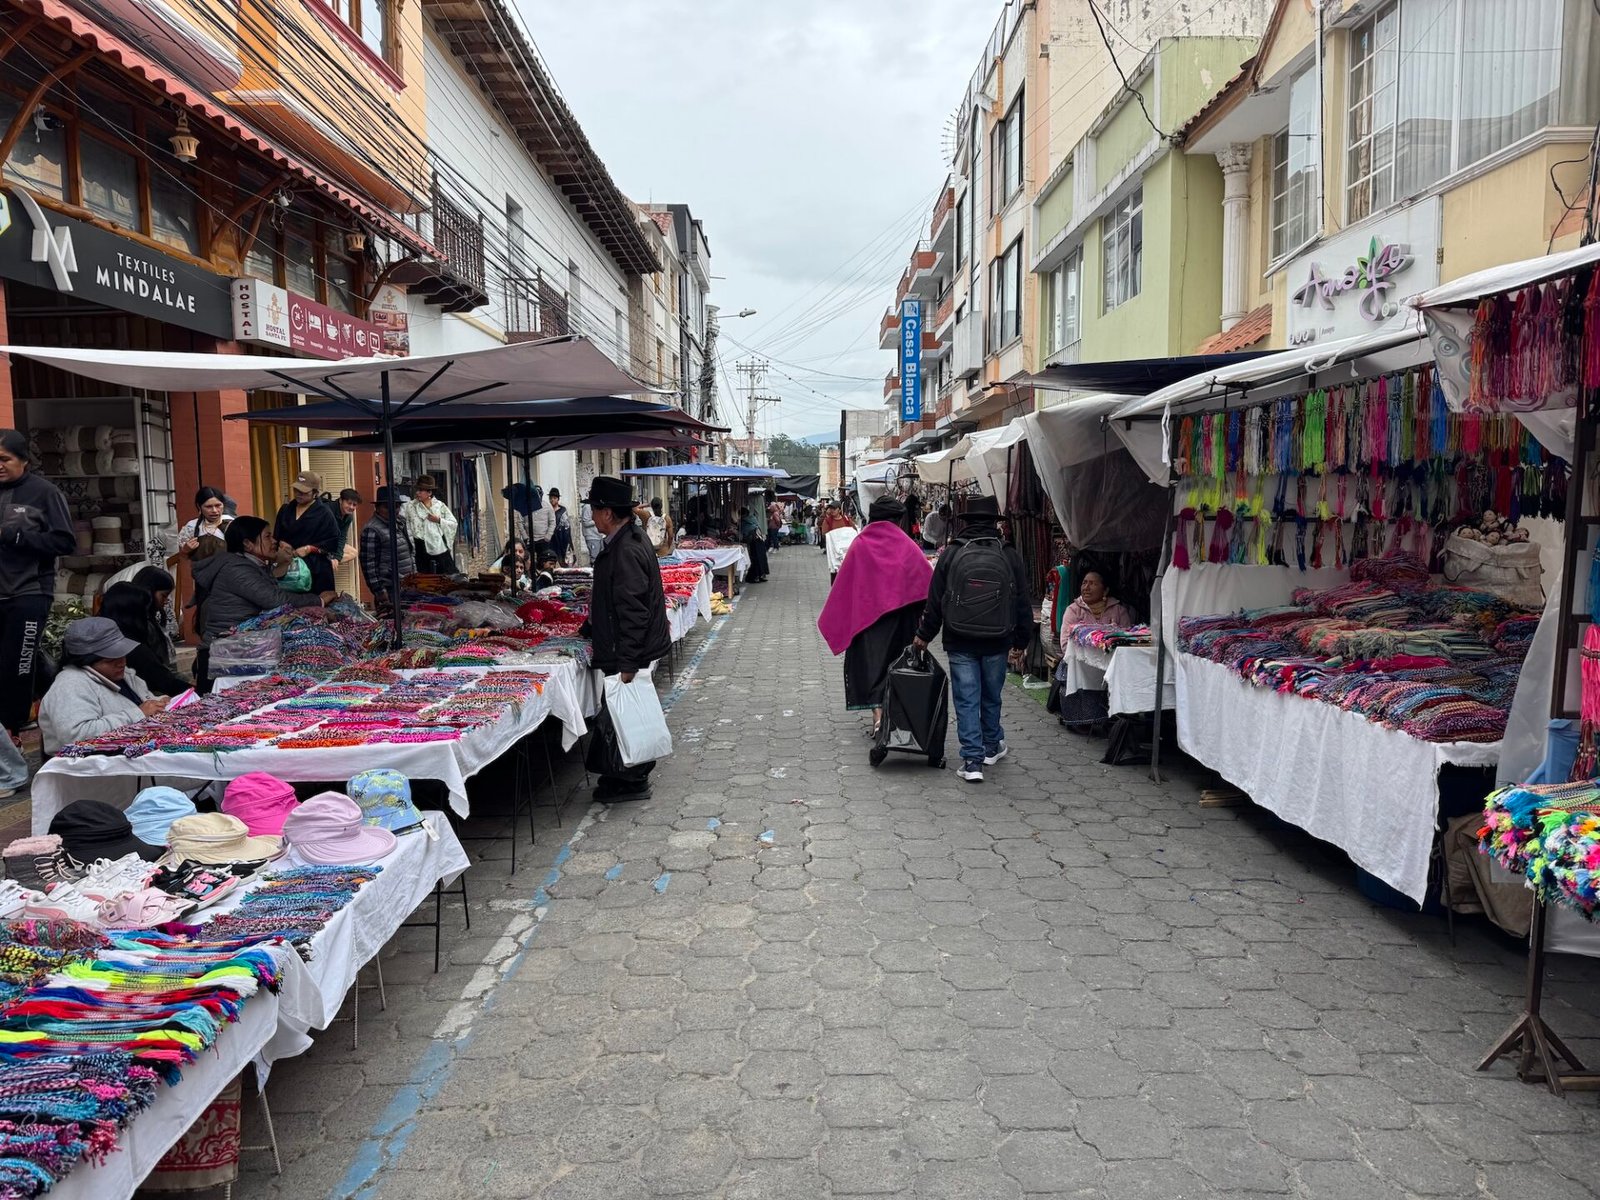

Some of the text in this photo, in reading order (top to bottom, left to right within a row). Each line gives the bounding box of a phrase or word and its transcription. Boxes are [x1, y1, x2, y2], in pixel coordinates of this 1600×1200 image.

[96, 264, 195, 313] MINDALAE
[116, 252, 175, 285] TEXTILES
[239, 284, 252, 336] HOSTAL
[265, 323, 286, 336] HOSTAL
[905, 319, 917, 415] Casa Blanca
[18, 621, 38, 676] HOLLISTER
